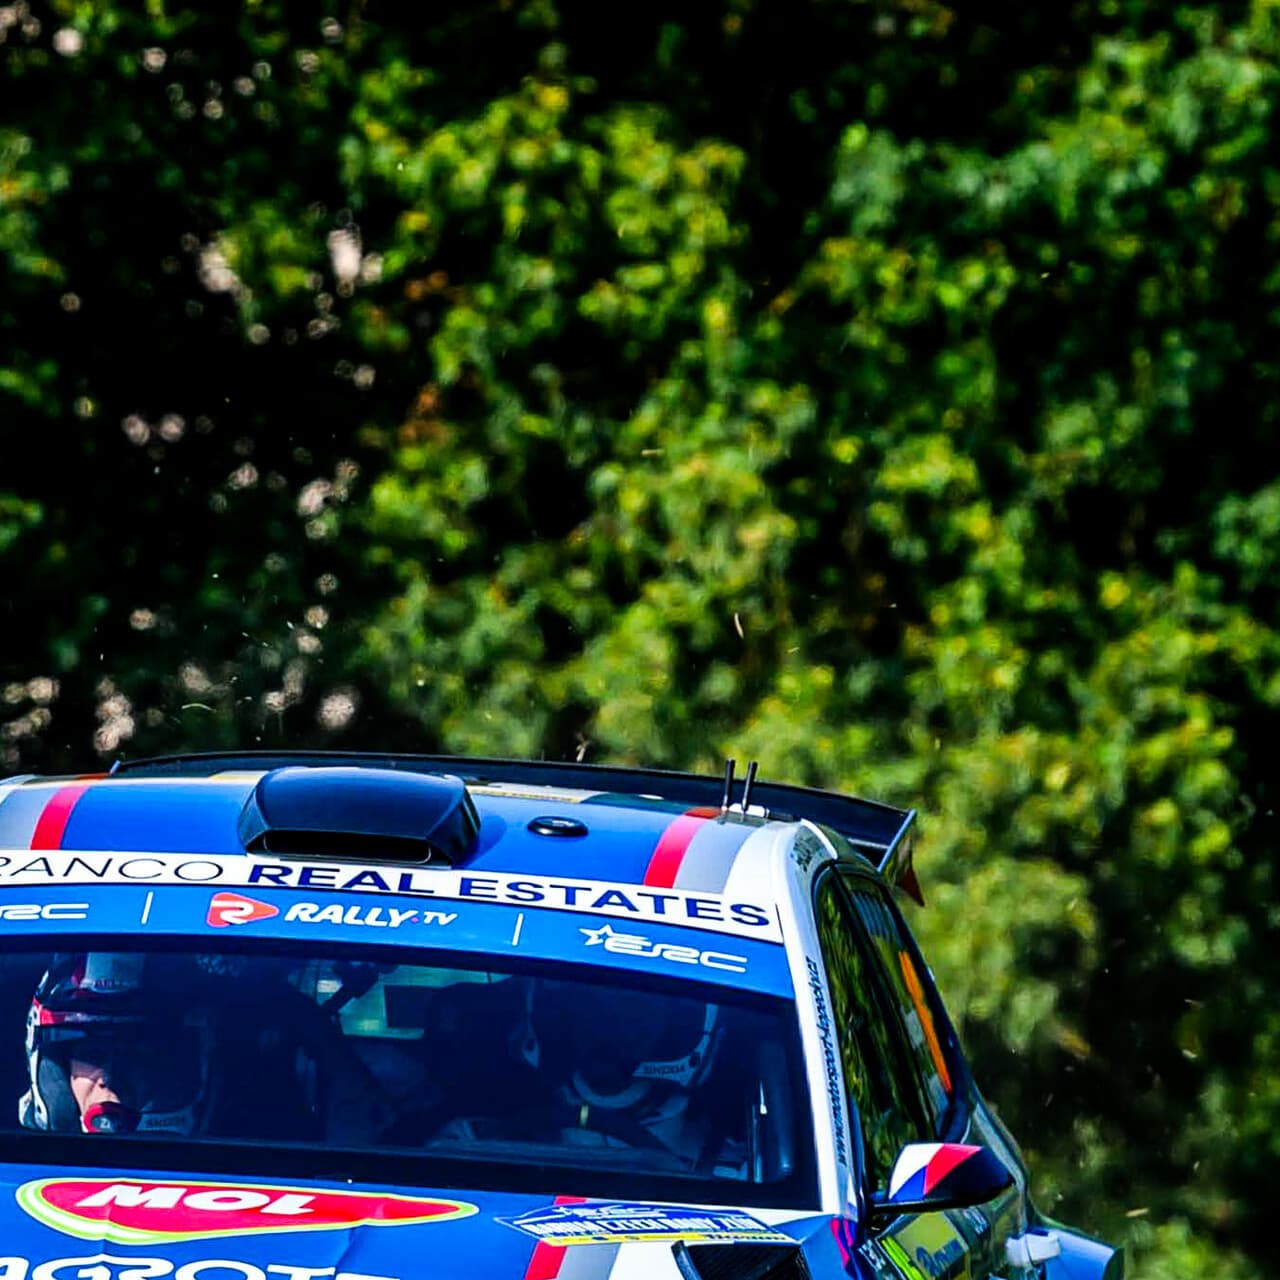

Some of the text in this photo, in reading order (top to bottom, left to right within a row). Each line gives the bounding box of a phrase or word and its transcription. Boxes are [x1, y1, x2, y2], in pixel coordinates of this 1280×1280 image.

[248, 864, 435, 893] REAL
[459, 877, 770, 927] ESTATES
[284, 902, 458, 927] RALLY TV
[604, 932, 748, 973] ERC
[76, 1184, 316, 1215] MOL
